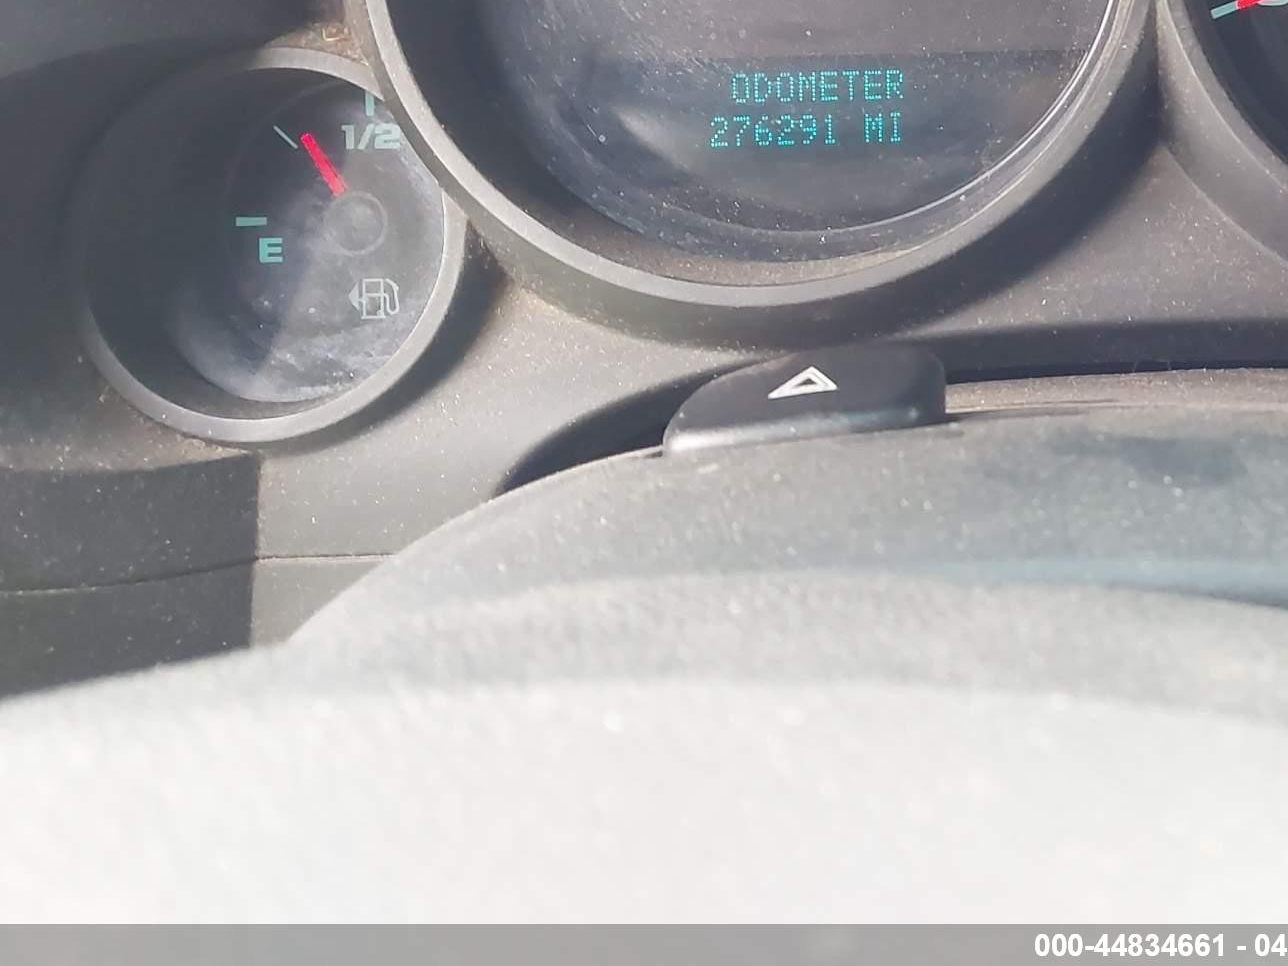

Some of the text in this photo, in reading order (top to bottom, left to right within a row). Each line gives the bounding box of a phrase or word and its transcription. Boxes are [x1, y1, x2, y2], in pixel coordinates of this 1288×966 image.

[730, 69, 904, 104] ODOMETER
[341, 123, 401, 151] 1/2
[710, 112, 902, 148] 276291 MI
[258, 237, 284, 263] E
